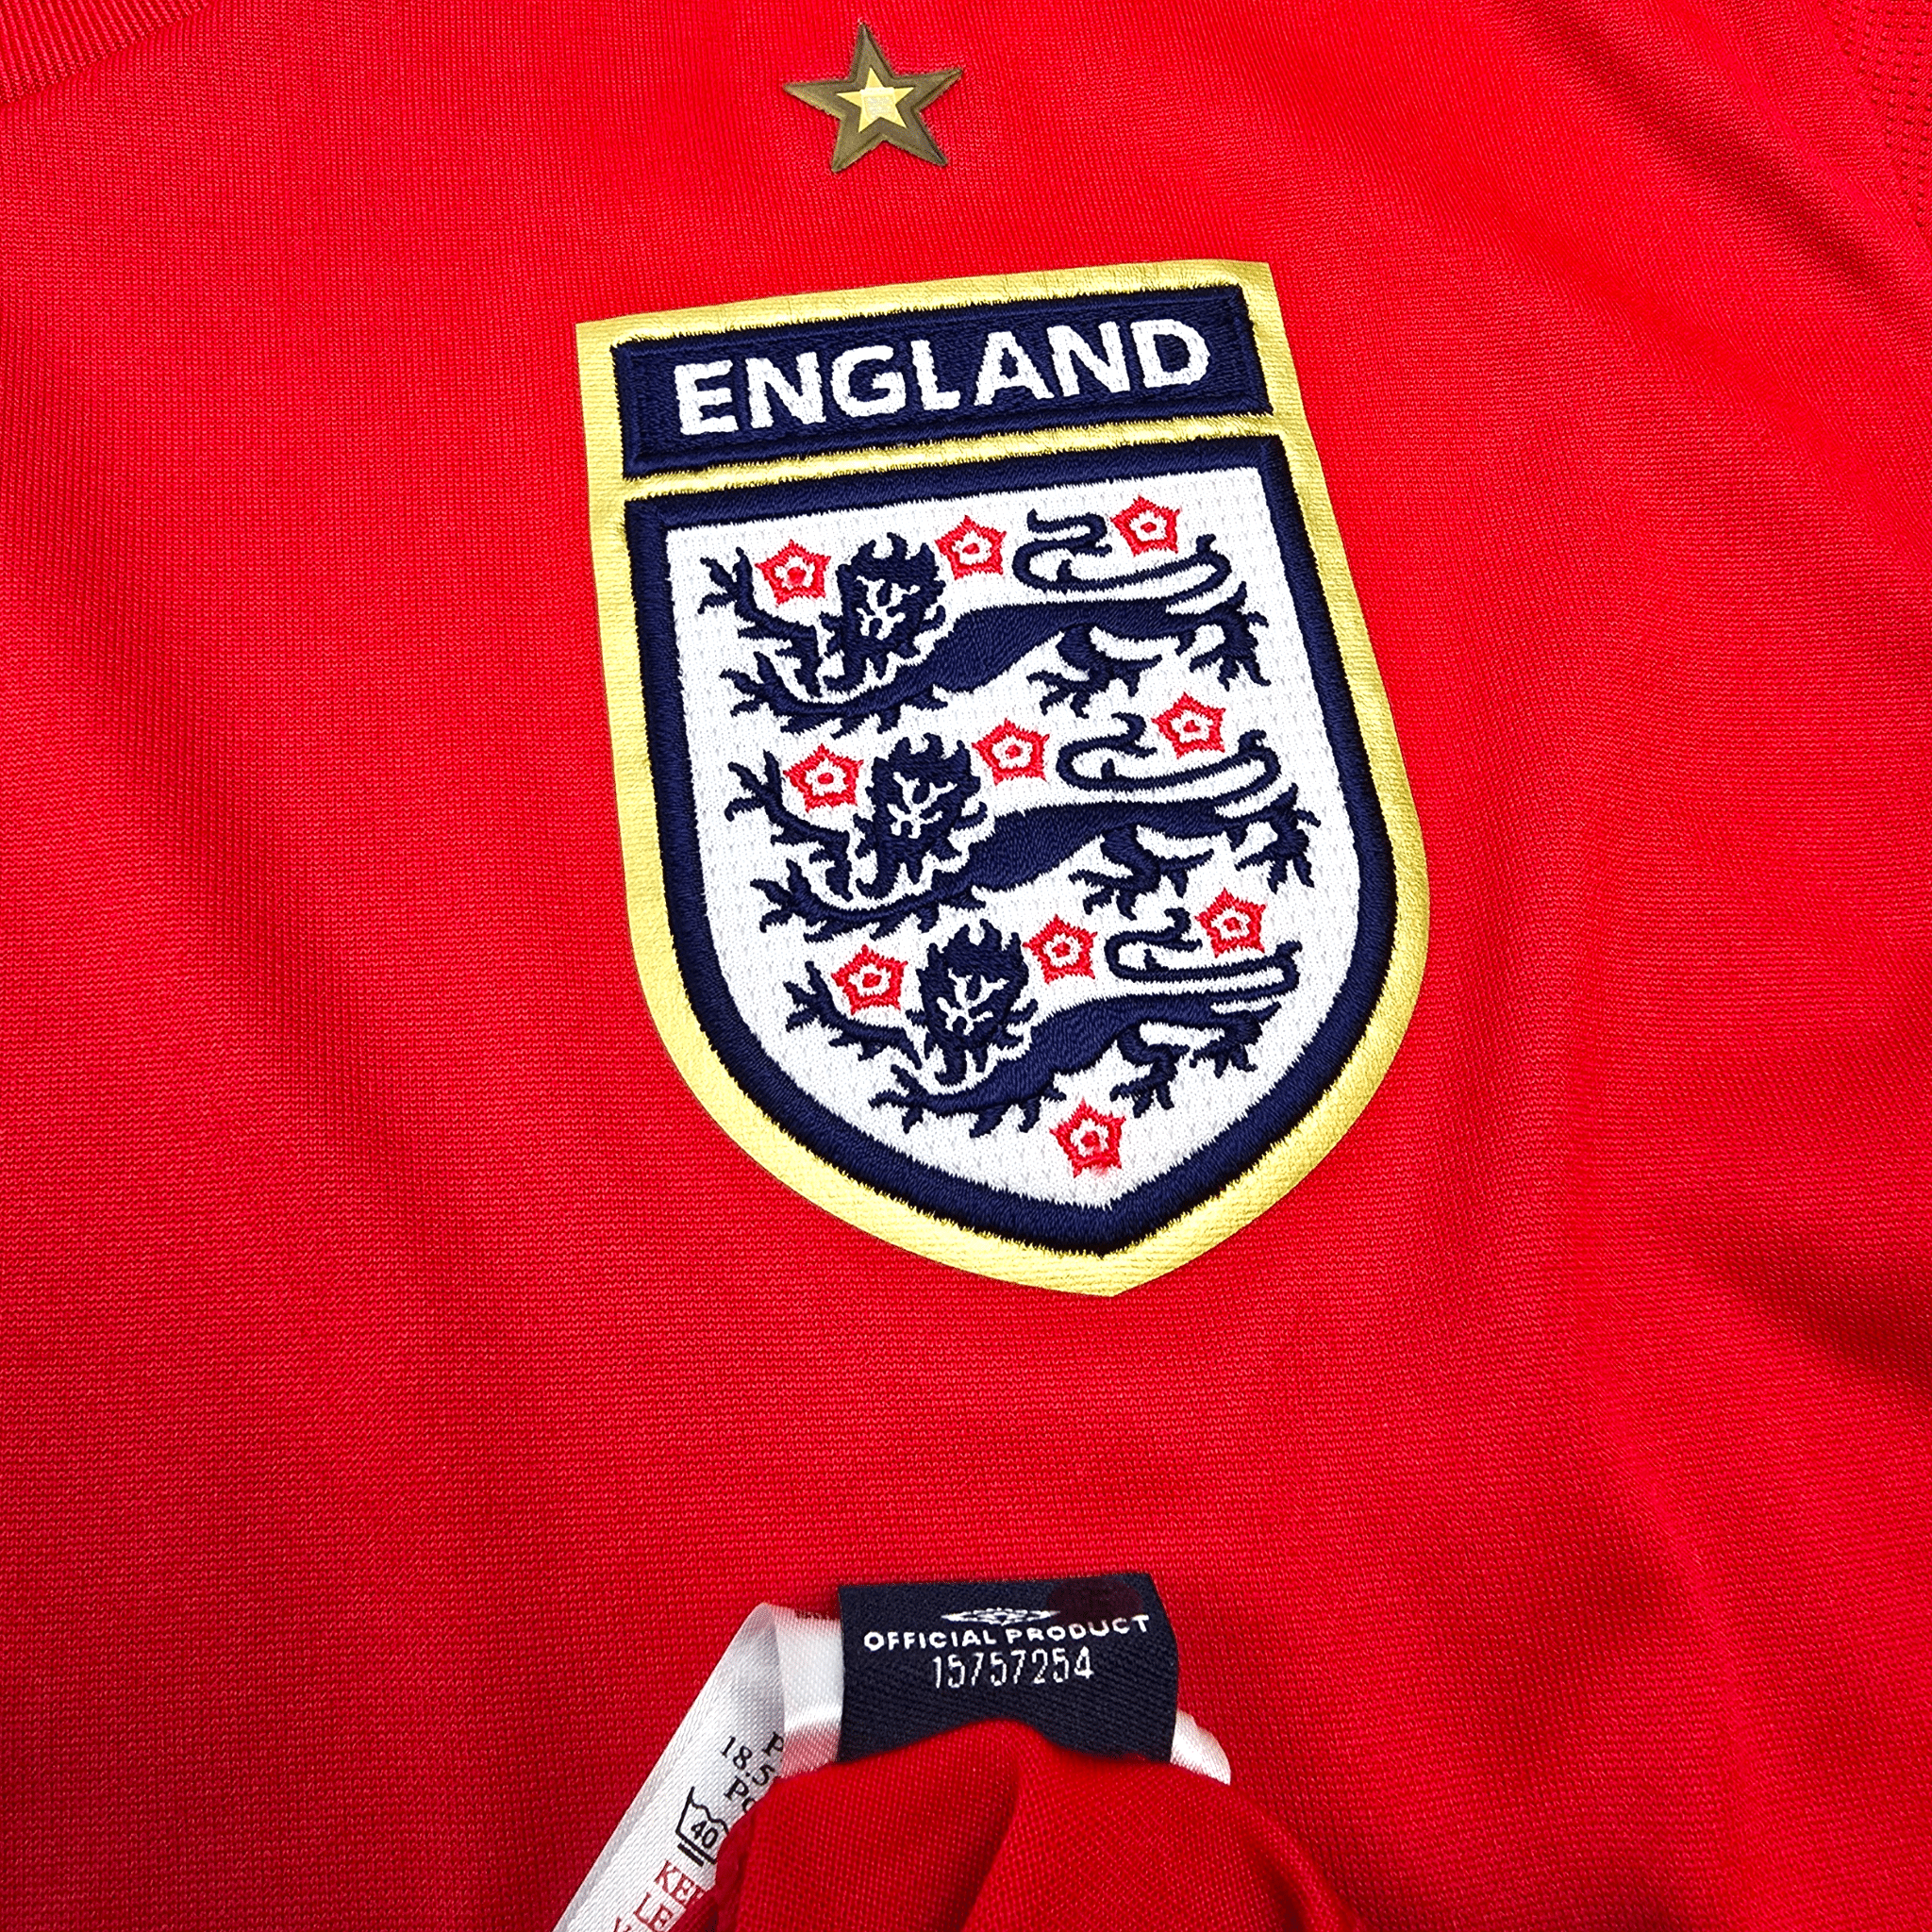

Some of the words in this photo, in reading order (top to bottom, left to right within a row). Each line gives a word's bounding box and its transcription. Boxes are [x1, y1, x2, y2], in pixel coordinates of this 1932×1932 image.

[675, 319, 1211, 435] ENGLAND
[863, 1628, 998, 1651] OFFICIAL
[1007, 1614, 1150, 1644] PRODUCT
[933, 1645, 1094, 1689] 15757254
[691, 1820, 719, 1849] 40
